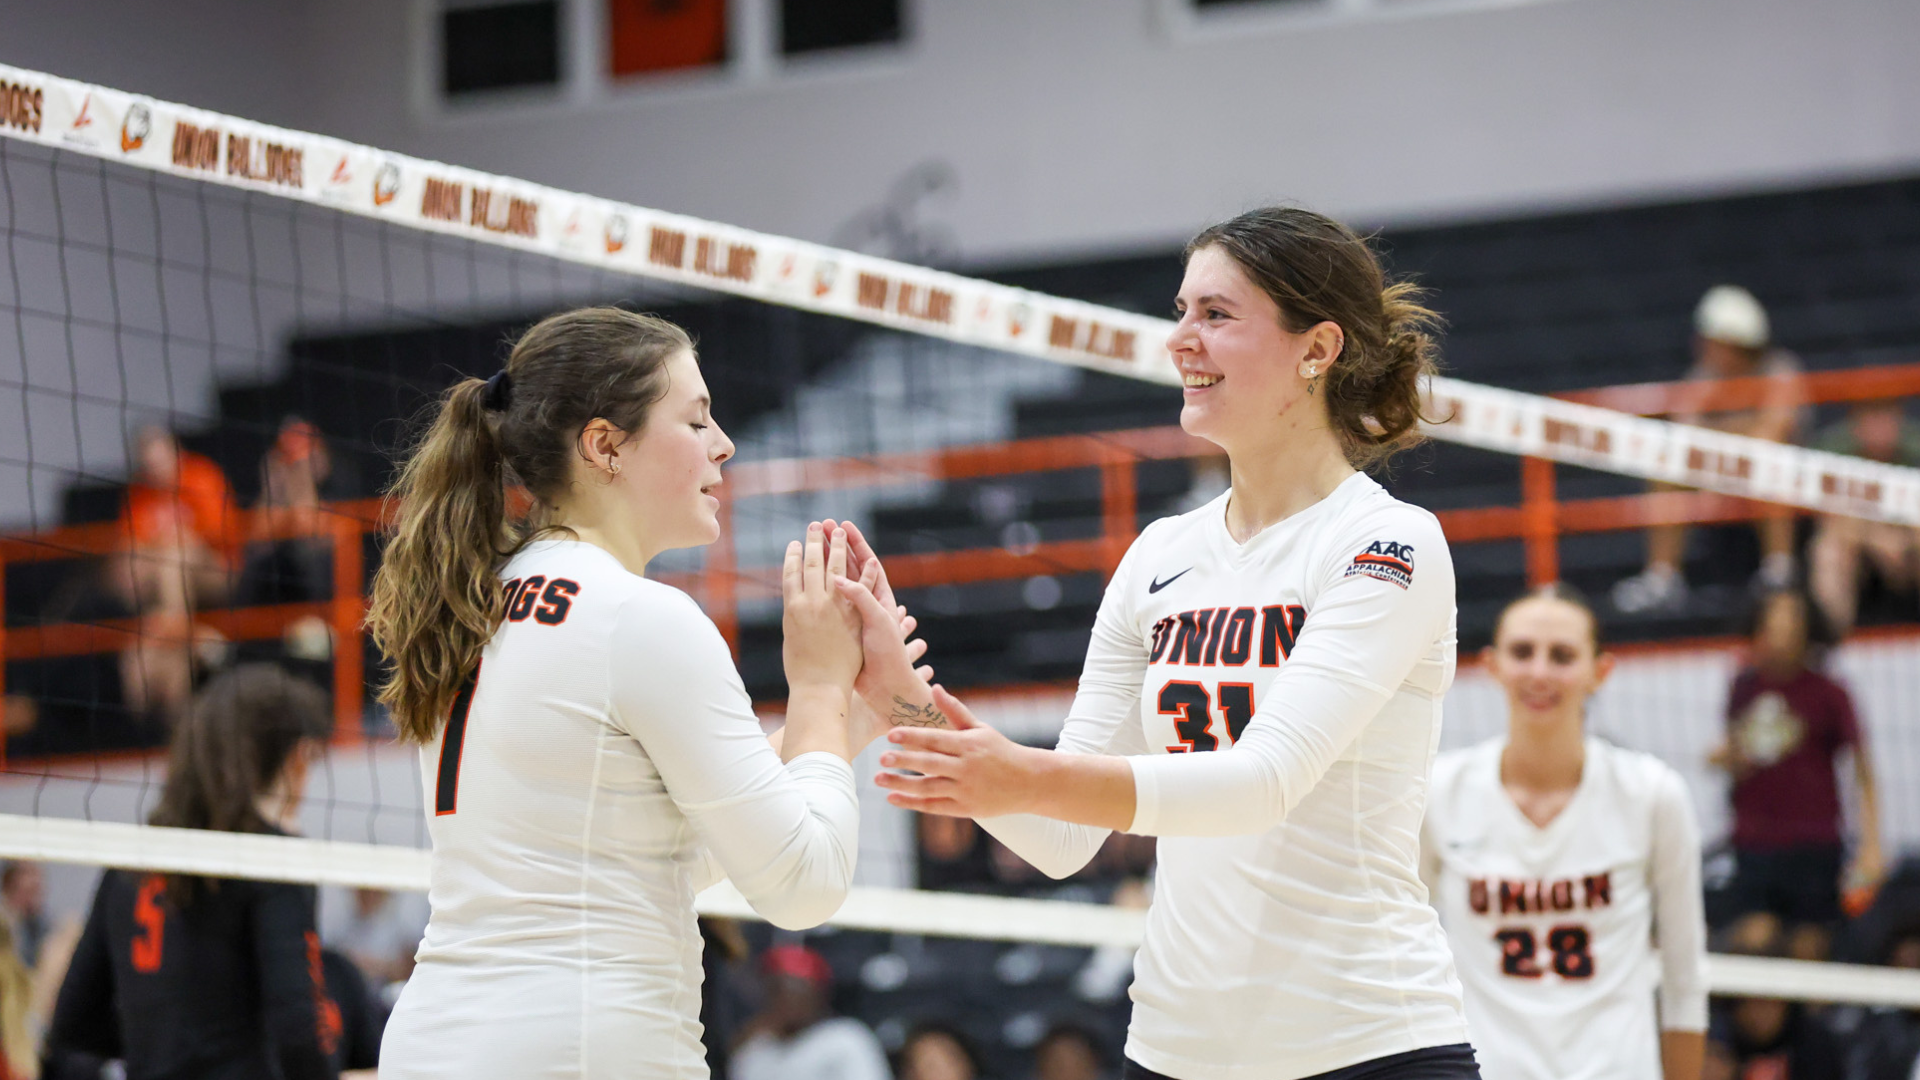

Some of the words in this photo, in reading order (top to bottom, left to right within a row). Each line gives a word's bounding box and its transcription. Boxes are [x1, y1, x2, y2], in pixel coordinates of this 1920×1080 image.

[1365, 540, 1415, 563] AAC
[1345, 563, 1413, 585] APPALACHIAN
[1149, 604, 1308, 668] UNION
[1468, 872, 1612, 915] UNION
[1494, 925, 1595, 981] 28
